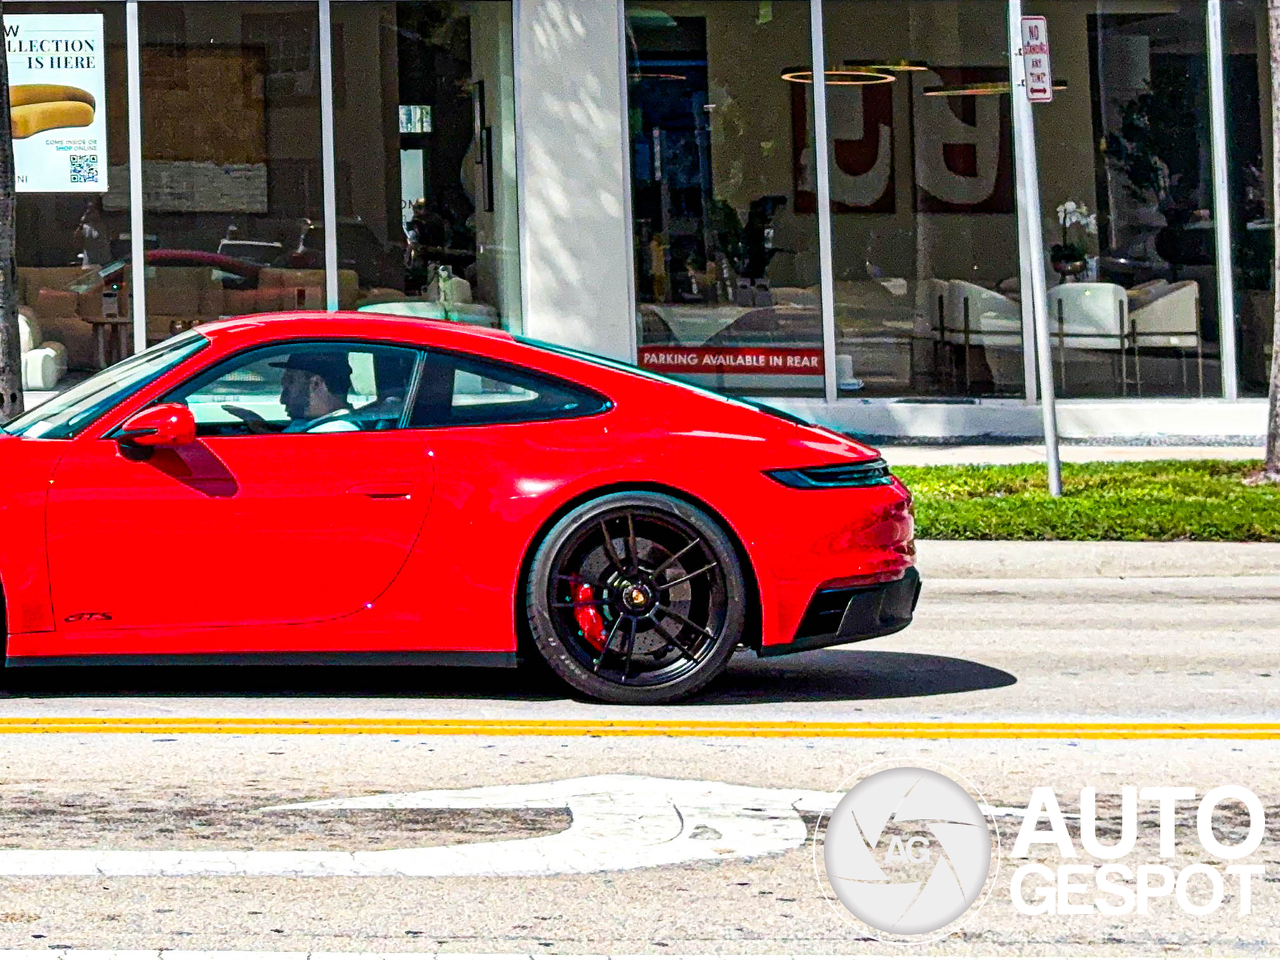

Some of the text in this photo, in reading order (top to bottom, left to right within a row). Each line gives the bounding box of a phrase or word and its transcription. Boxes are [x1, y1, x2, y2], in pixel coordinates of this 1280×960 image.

[1028, 25, 1040, 41] NO
[7, 39, 95, 52] LLECTION
[27, 56, 96, 69] IS HERE
[643, 353, 818, 367] PARKING AVAILABLE IN REAR
[64, 612, 112, 622] GTS
